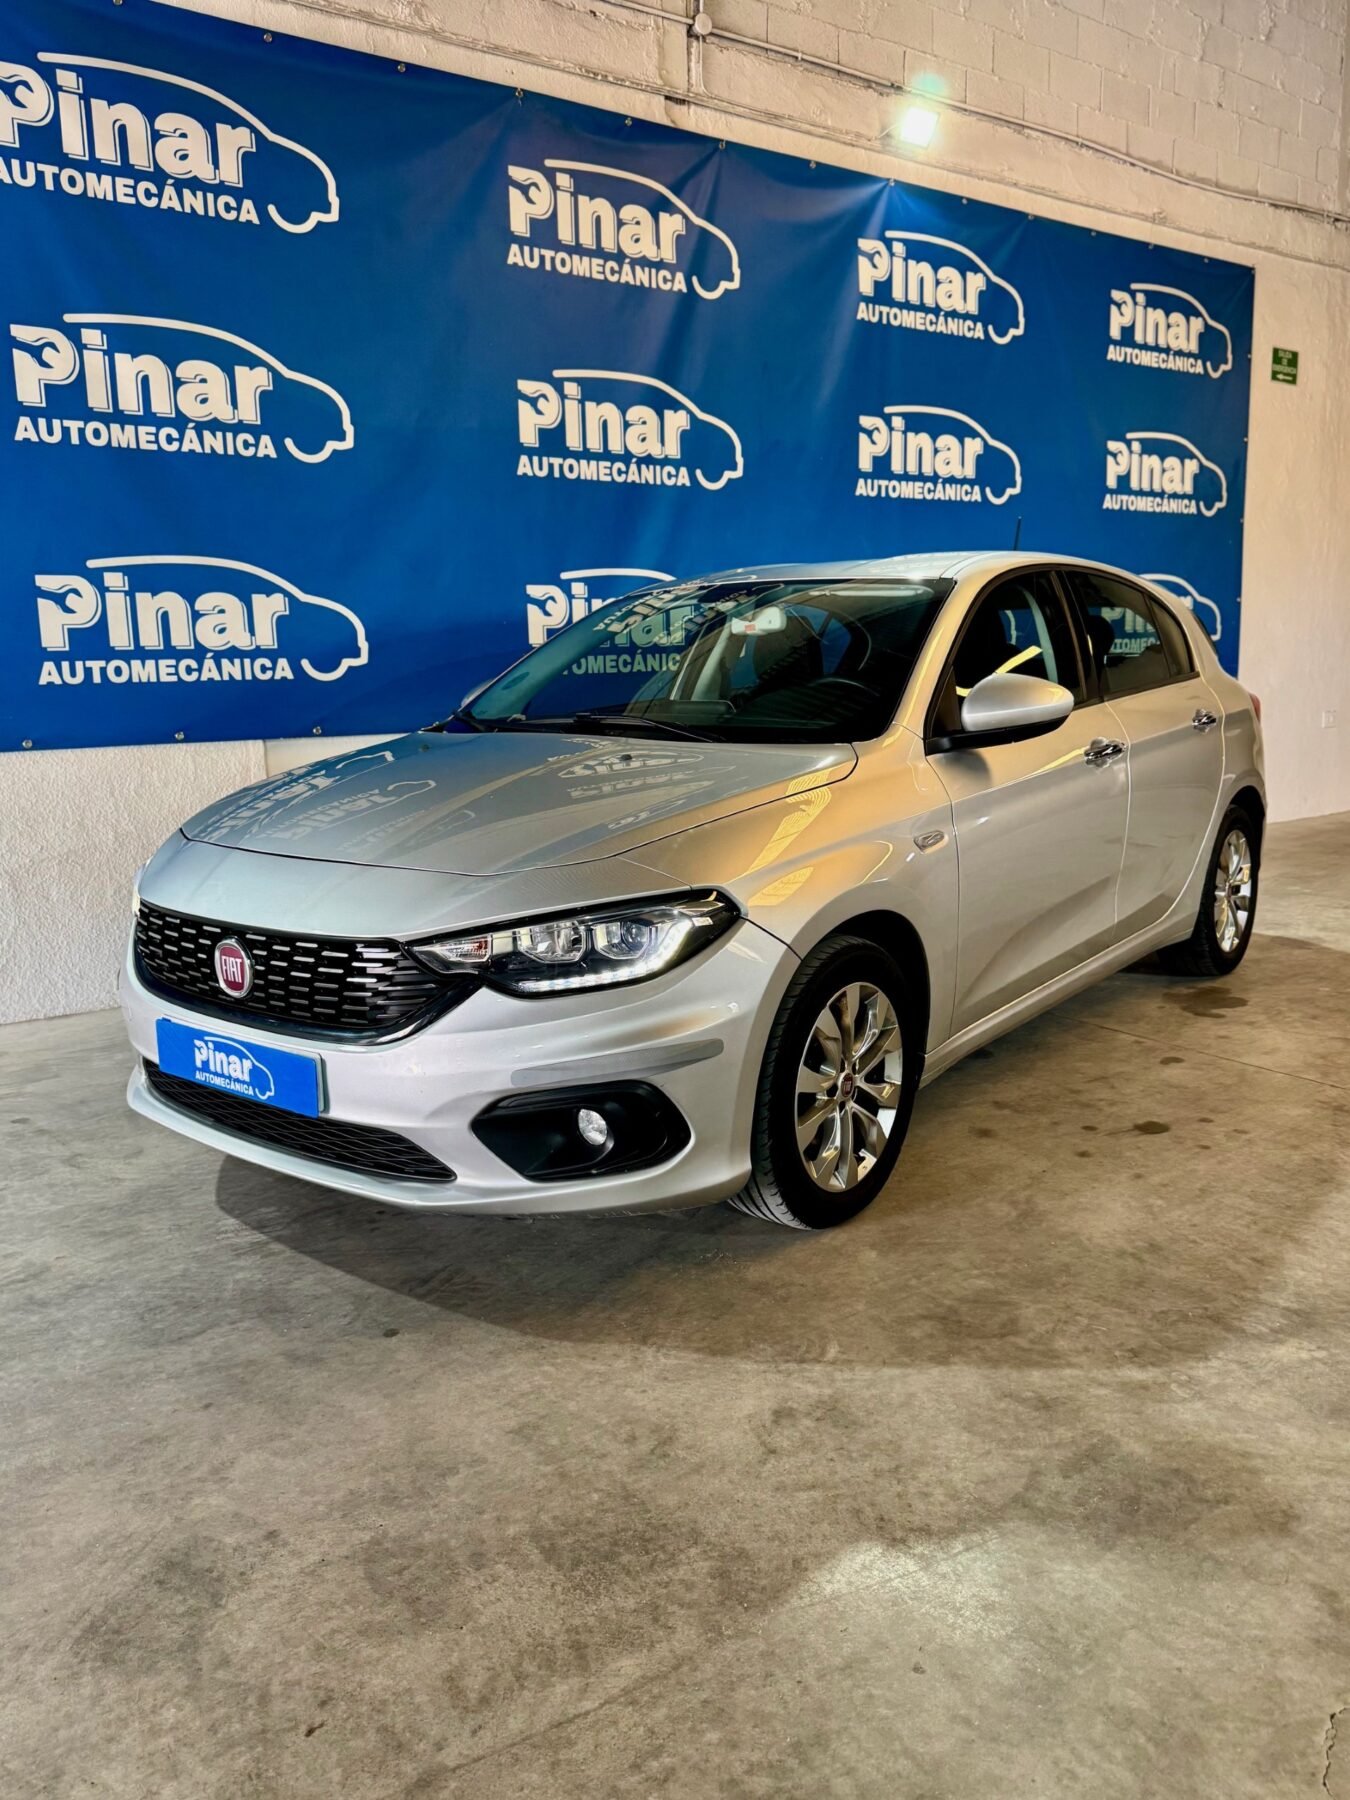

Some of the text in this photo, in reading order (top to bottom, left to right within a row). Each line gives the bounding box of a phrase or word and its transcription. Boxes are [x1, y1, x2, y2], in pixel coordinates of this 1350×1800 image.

[0, 60, 257, 188] Pinar
[508, 164, 688, 265] Pinar
[506, 243, 688, 293] AUTOMECÁNICA
[857, 238, 987, 316] Pinar
[856, 302, 985, 341] AUTOMECÁNICA
[1109, 289, 1205, 354] Pinar
[9, 323, 274, 425] Pinar
[1106, 344, 1204, 375] AUTOMECÁNICA
[14, 416, 278, 459] AUTOMECÁNICA
[516, 379, 691, 459] Pinar
[516, 454, 691, 487] AUTOMECÁNICA
[858, 415, 984, 480] Pinar
[1106, 440, 1200, 495] Pinar
[855, 478, 982, 502] AUTOMECÁNICA
[1102, 494, 1198, 515] AUTOMECÁNICA
[34, 571, 290, 652] Pinar
[38, 652, 294, 685] AUTOMECÁNICA
[221, 955, 243, 983] FIAT
[194, 1039, 253, 1082] Pinar
[195, 1070, 254, 1096] AUTOMECÁNICA
